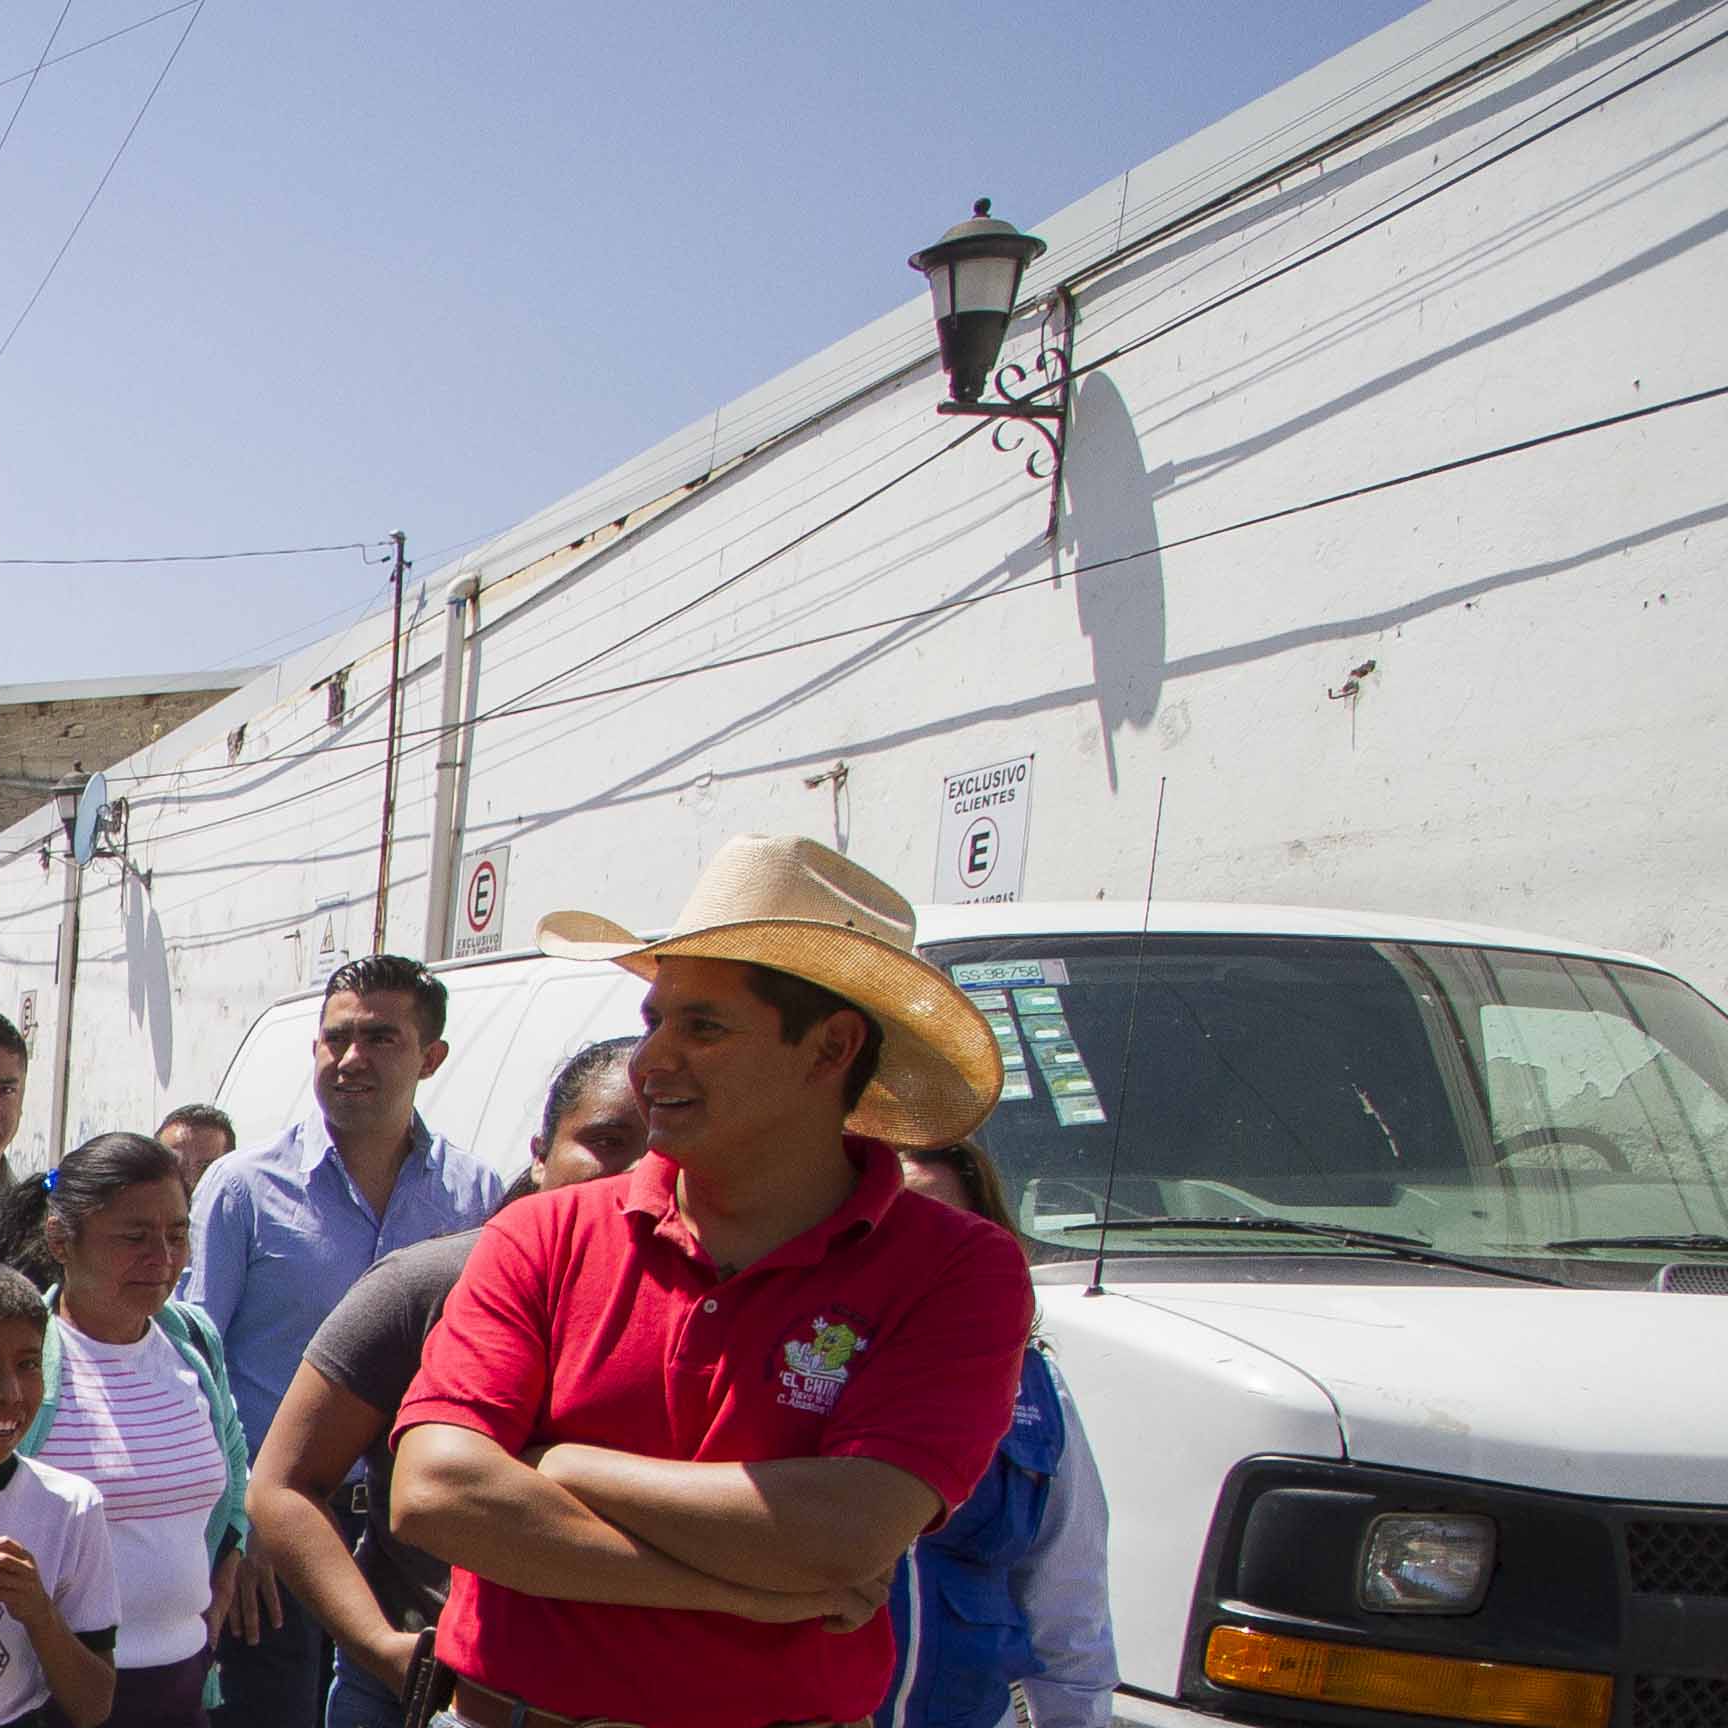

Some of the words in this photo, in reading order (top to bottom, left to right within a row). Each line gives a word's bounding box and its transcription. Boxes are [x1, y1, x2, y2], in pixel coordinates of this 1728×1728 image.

[949, 764, 1026, 800] EXCLUSIVO
[954, 788, 1016, 815] CLIENTES
[967, 831, 991, 873] E
[474, 874, 490, 917] E
